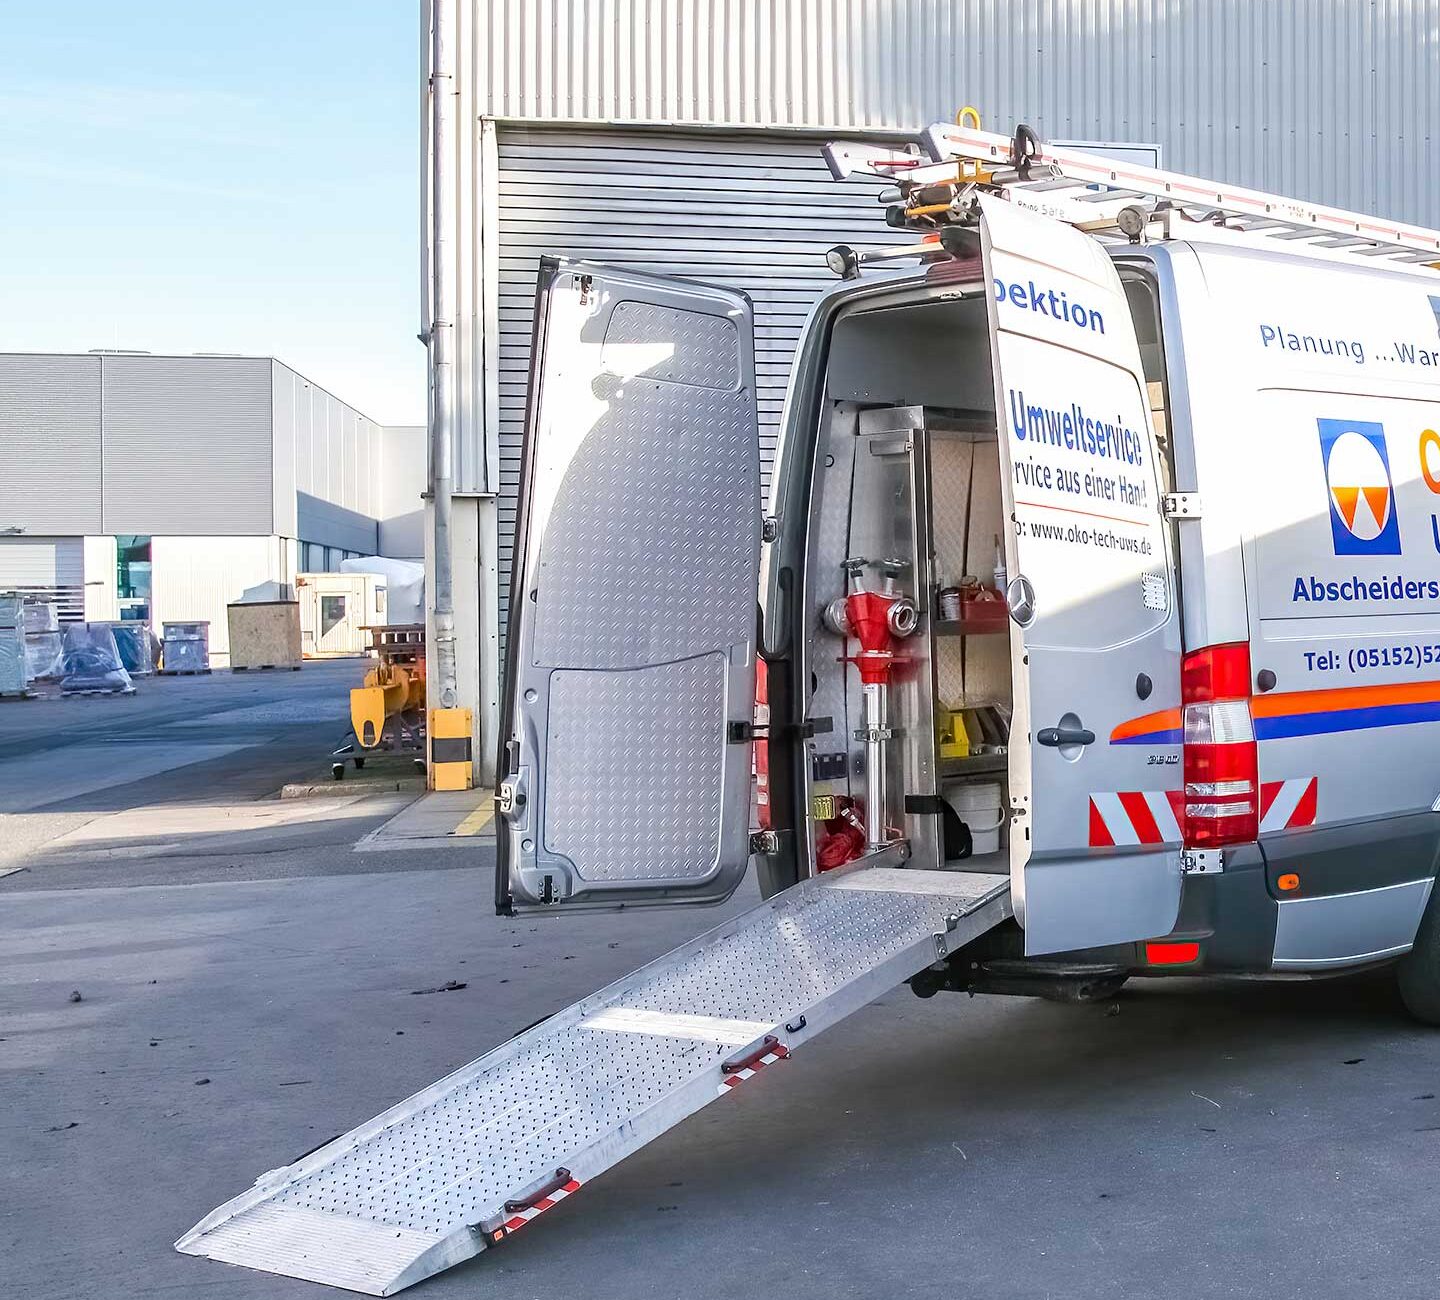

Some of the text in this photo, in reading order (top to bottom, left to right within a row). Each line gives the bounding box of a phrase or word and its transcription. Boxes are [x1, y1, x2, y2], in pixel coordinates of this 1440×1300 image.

[1259, 324, 1365, 366] Planung
[1009, 389, 1143, 467] Umweltservice
[1056, 468, 1081, 494] aus
[1084, 467, 1116, 501] einer
[1030, 521, 1152, 556] www.oko-tech-uws.de
[1303, 650, 1341, 671] Tel:
